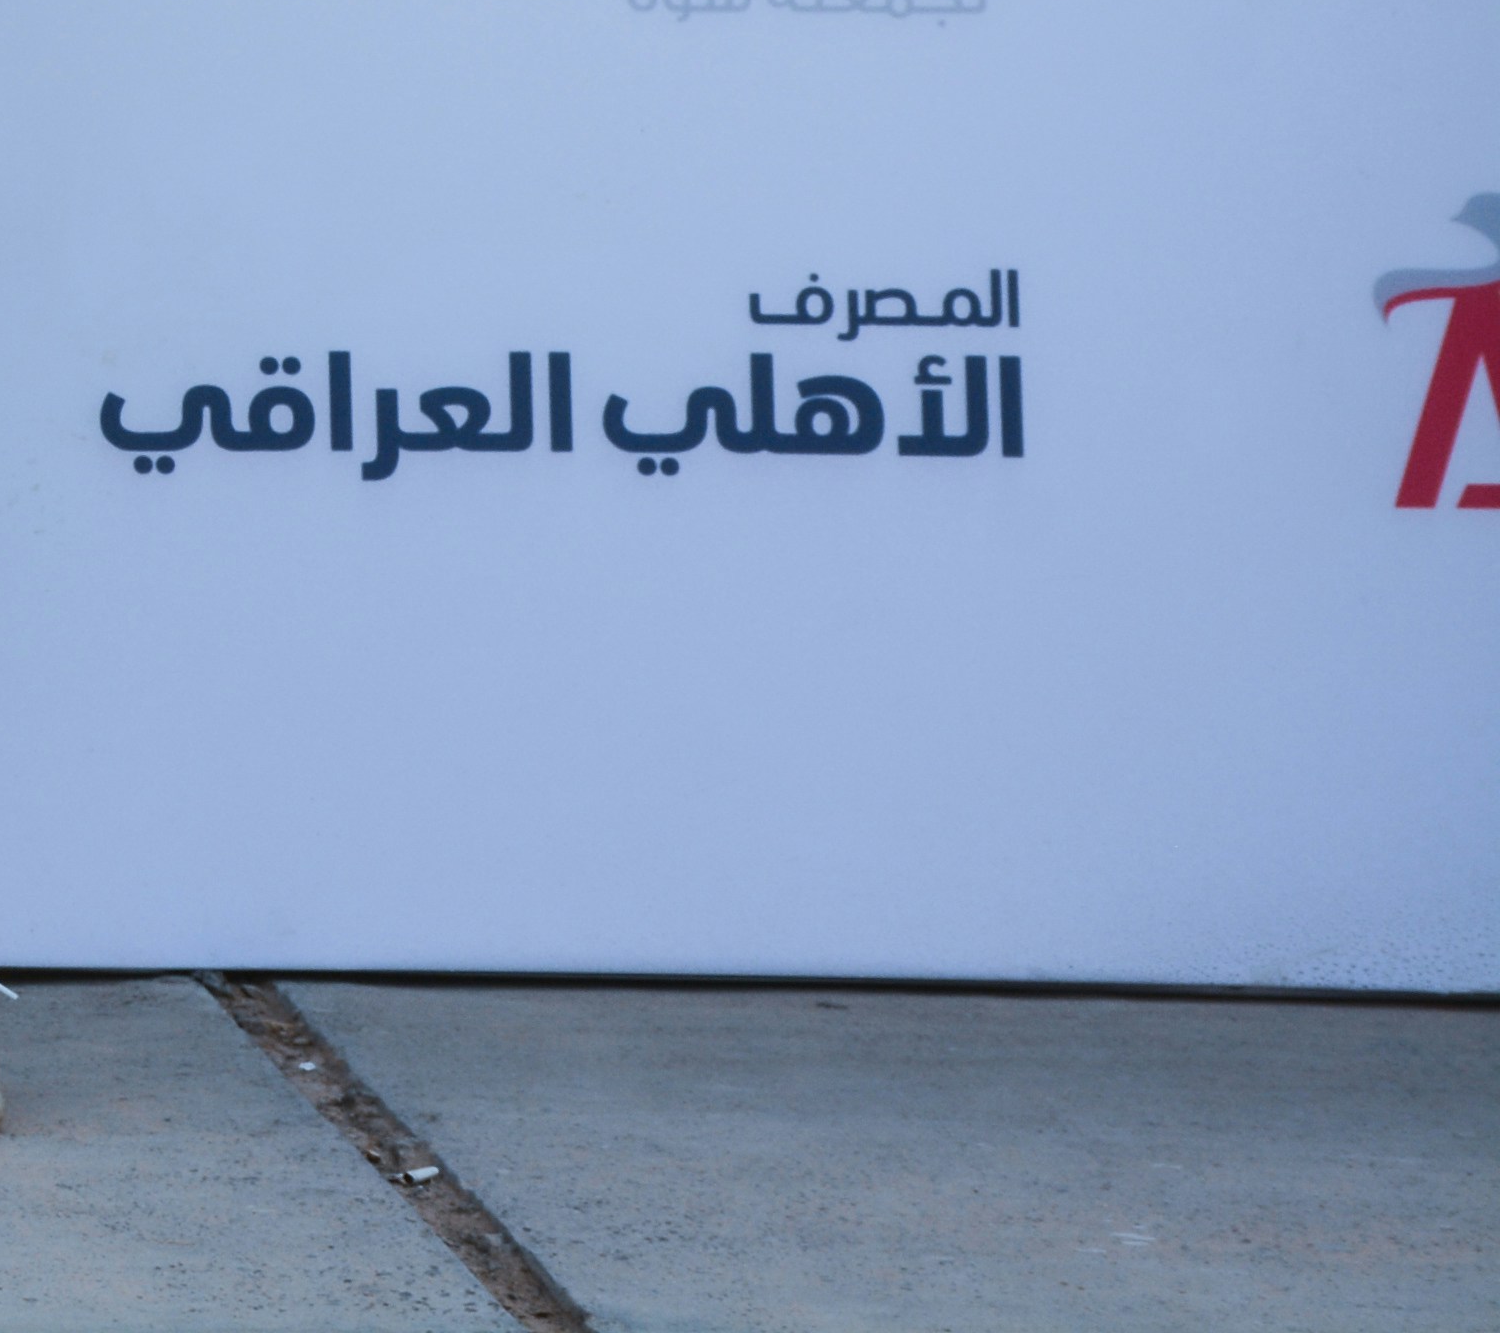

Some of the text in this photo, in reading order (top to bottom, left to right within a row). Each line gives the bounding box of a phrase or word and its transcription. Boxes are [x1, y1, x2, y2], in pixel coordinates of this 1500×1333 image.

[749, 268, 1020, 341] المصرف
[99, 350, 1025, 482] الأهلي العراقي
